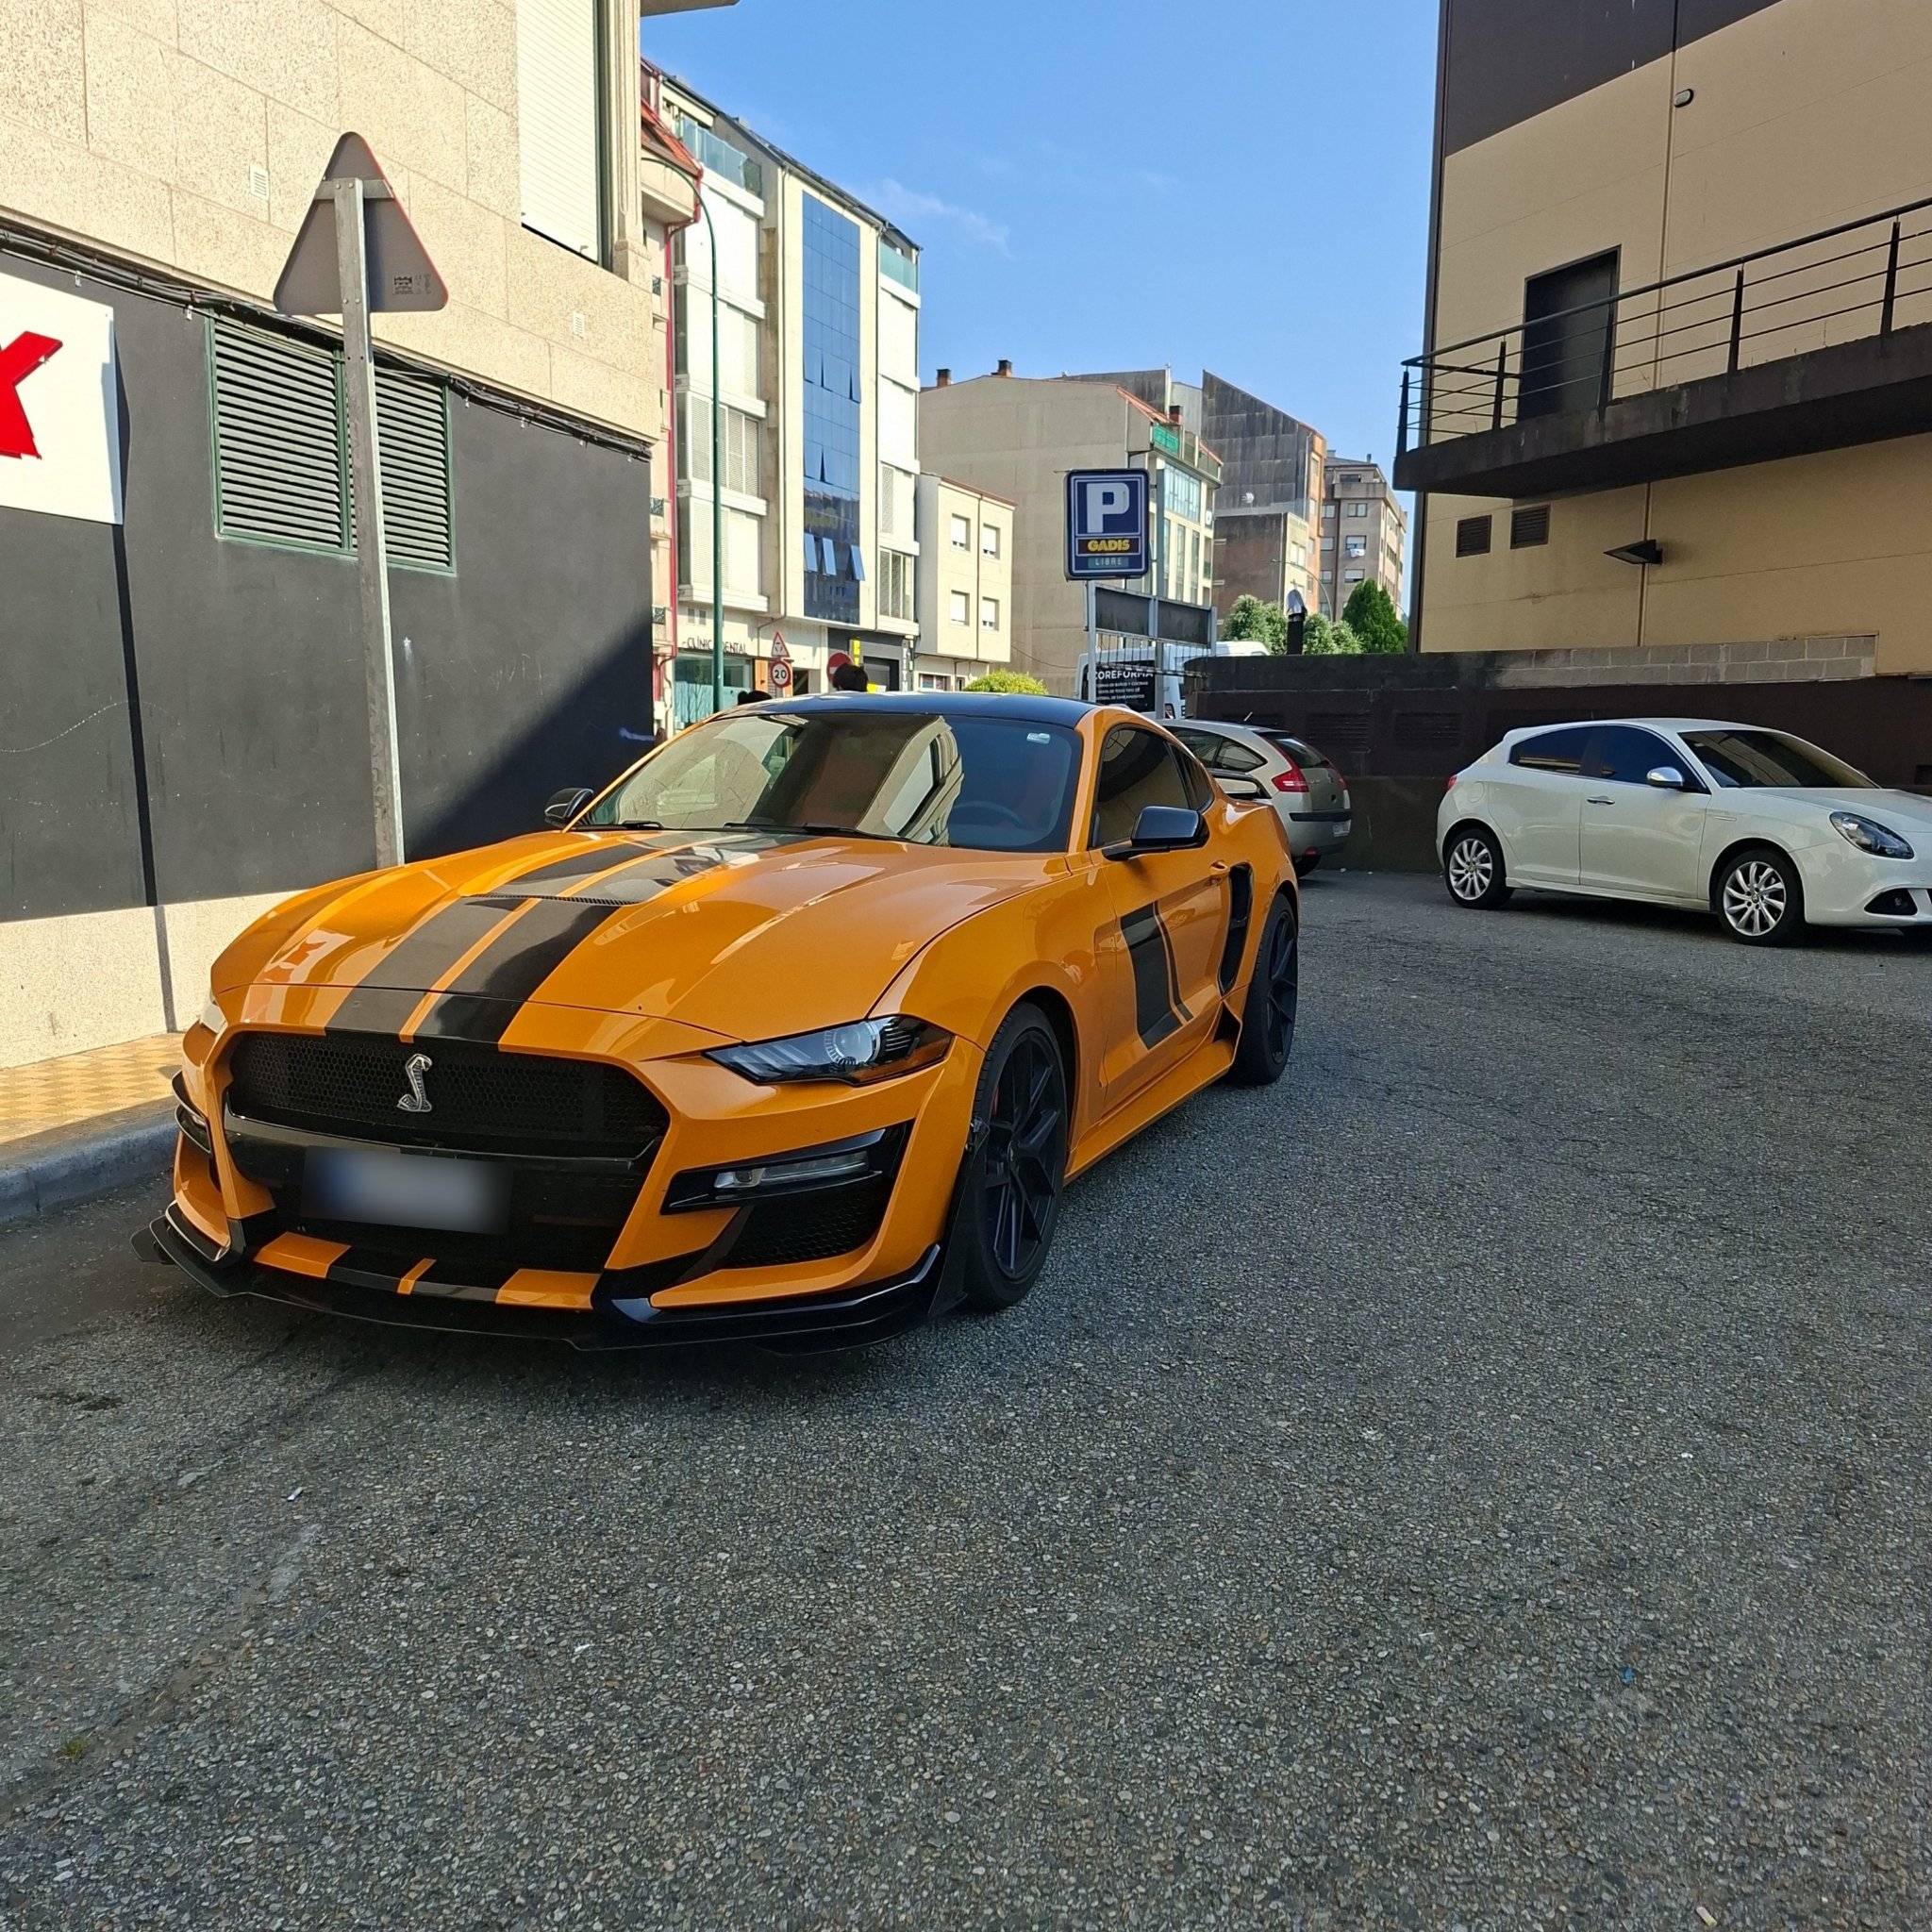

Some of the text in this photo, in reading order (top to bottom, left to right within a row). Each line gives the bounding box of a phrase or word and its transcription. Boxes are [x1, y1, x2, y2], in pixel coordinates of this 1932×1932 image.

[1087, 482, 1129, 533] P
[1088, 540, 1130, 552] GADIS
[1095, 558, 1123, 566] LIBRE
[687, 636, 712, 650] CLÍNIC
[774, 669, 787, 678] 20
